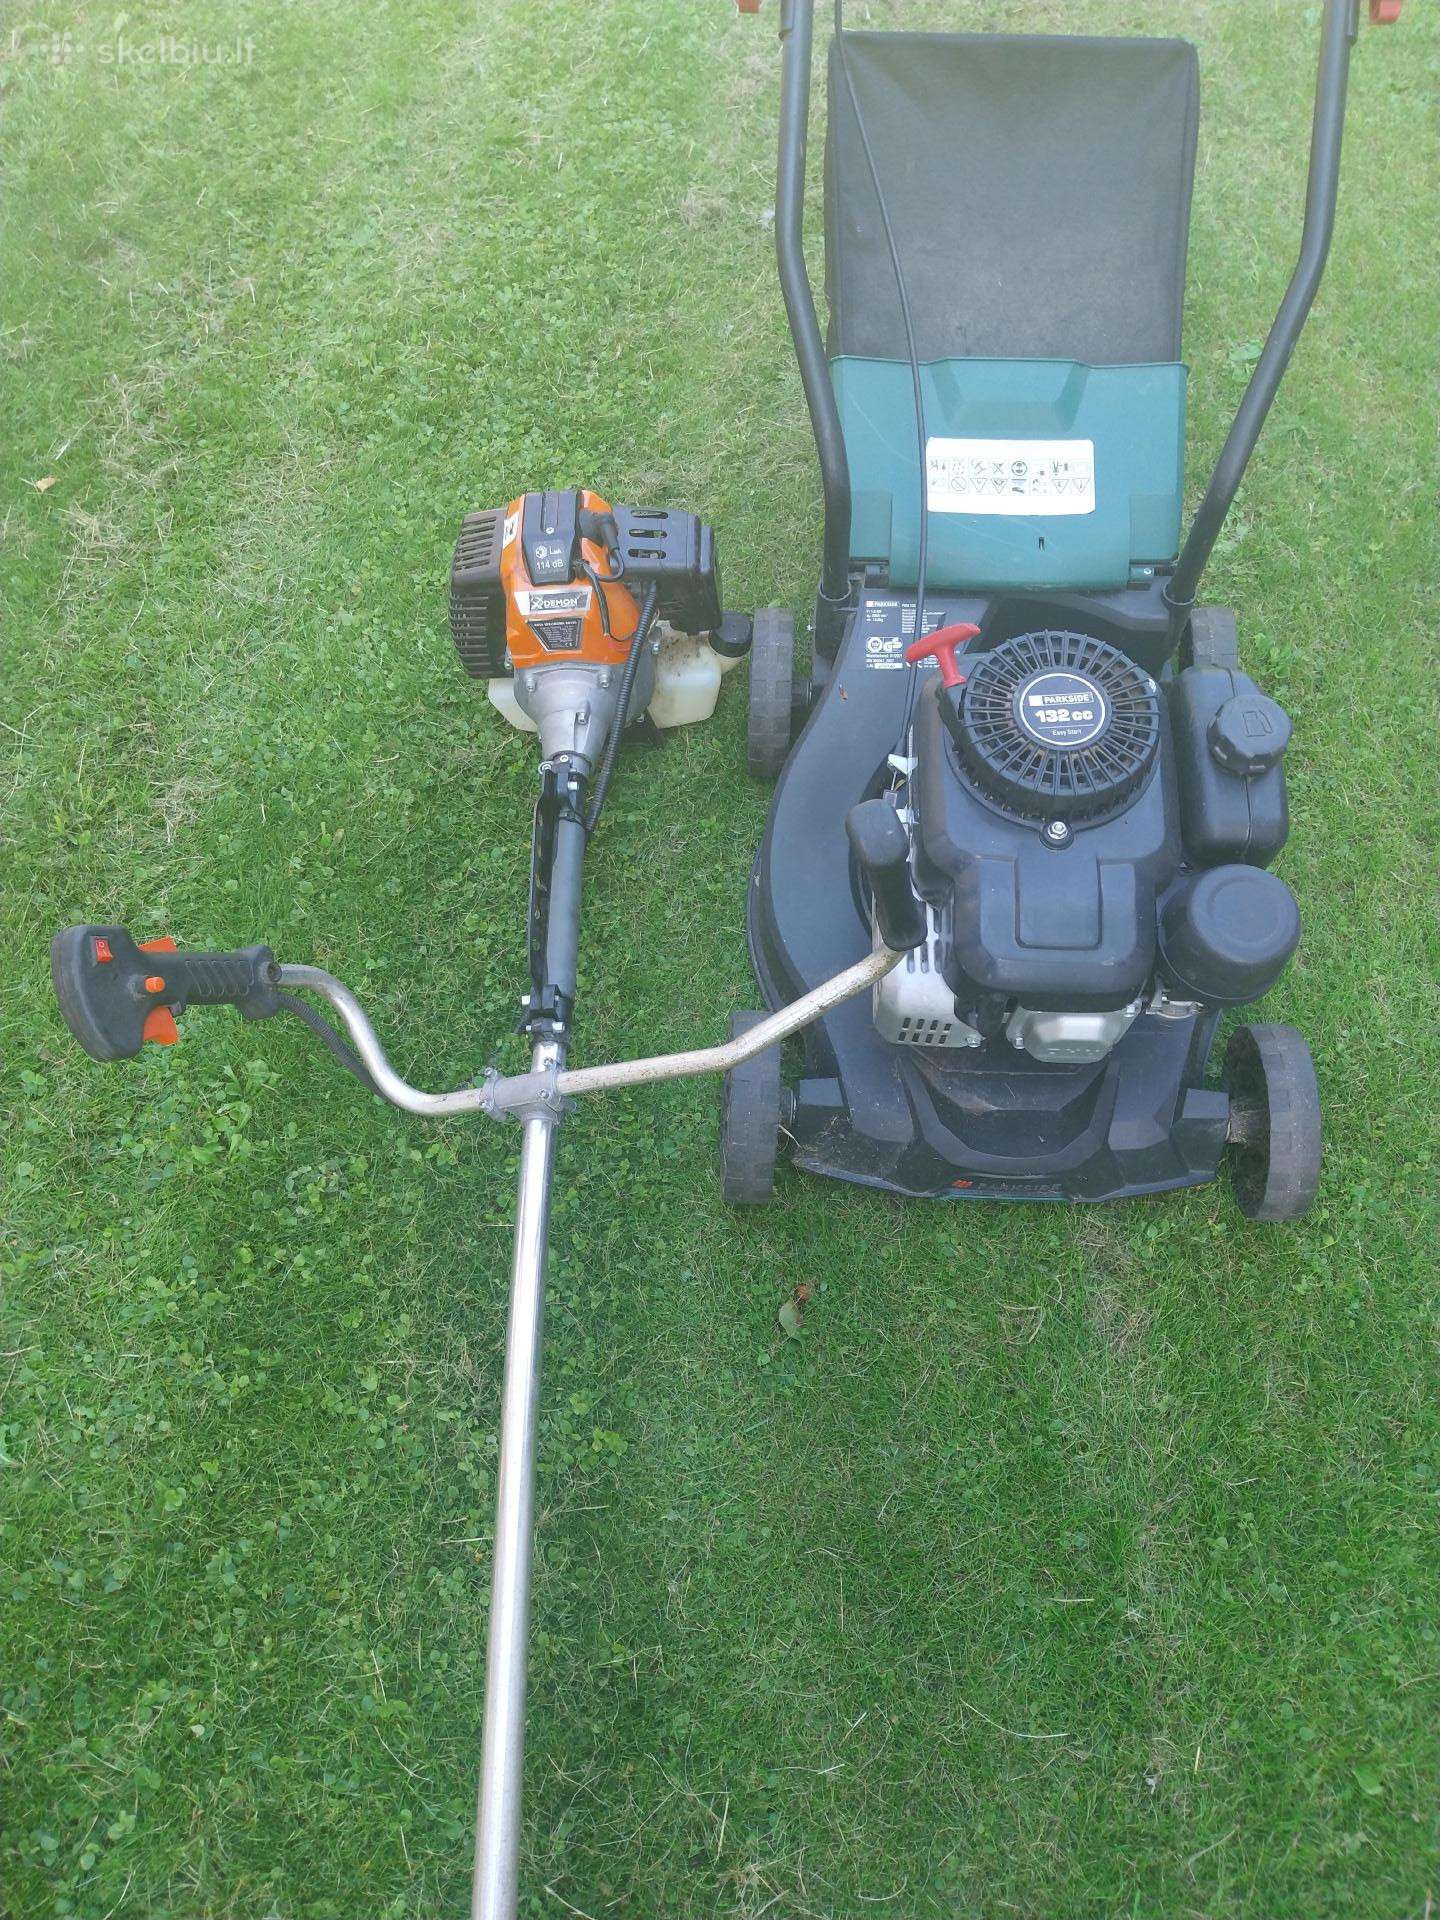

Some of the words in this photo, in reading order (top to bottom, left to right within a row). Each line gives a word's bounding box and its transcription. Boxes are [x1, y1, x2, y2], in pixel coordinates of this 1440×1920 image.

[536, 560, 551, 570] 114
[552, 559, 565, 569] dB
[1044, 694, 1090, 704] PARKSIDE
[1035, 709, 1071, 723] 132
[1072, 710, 1093, 721] cc
